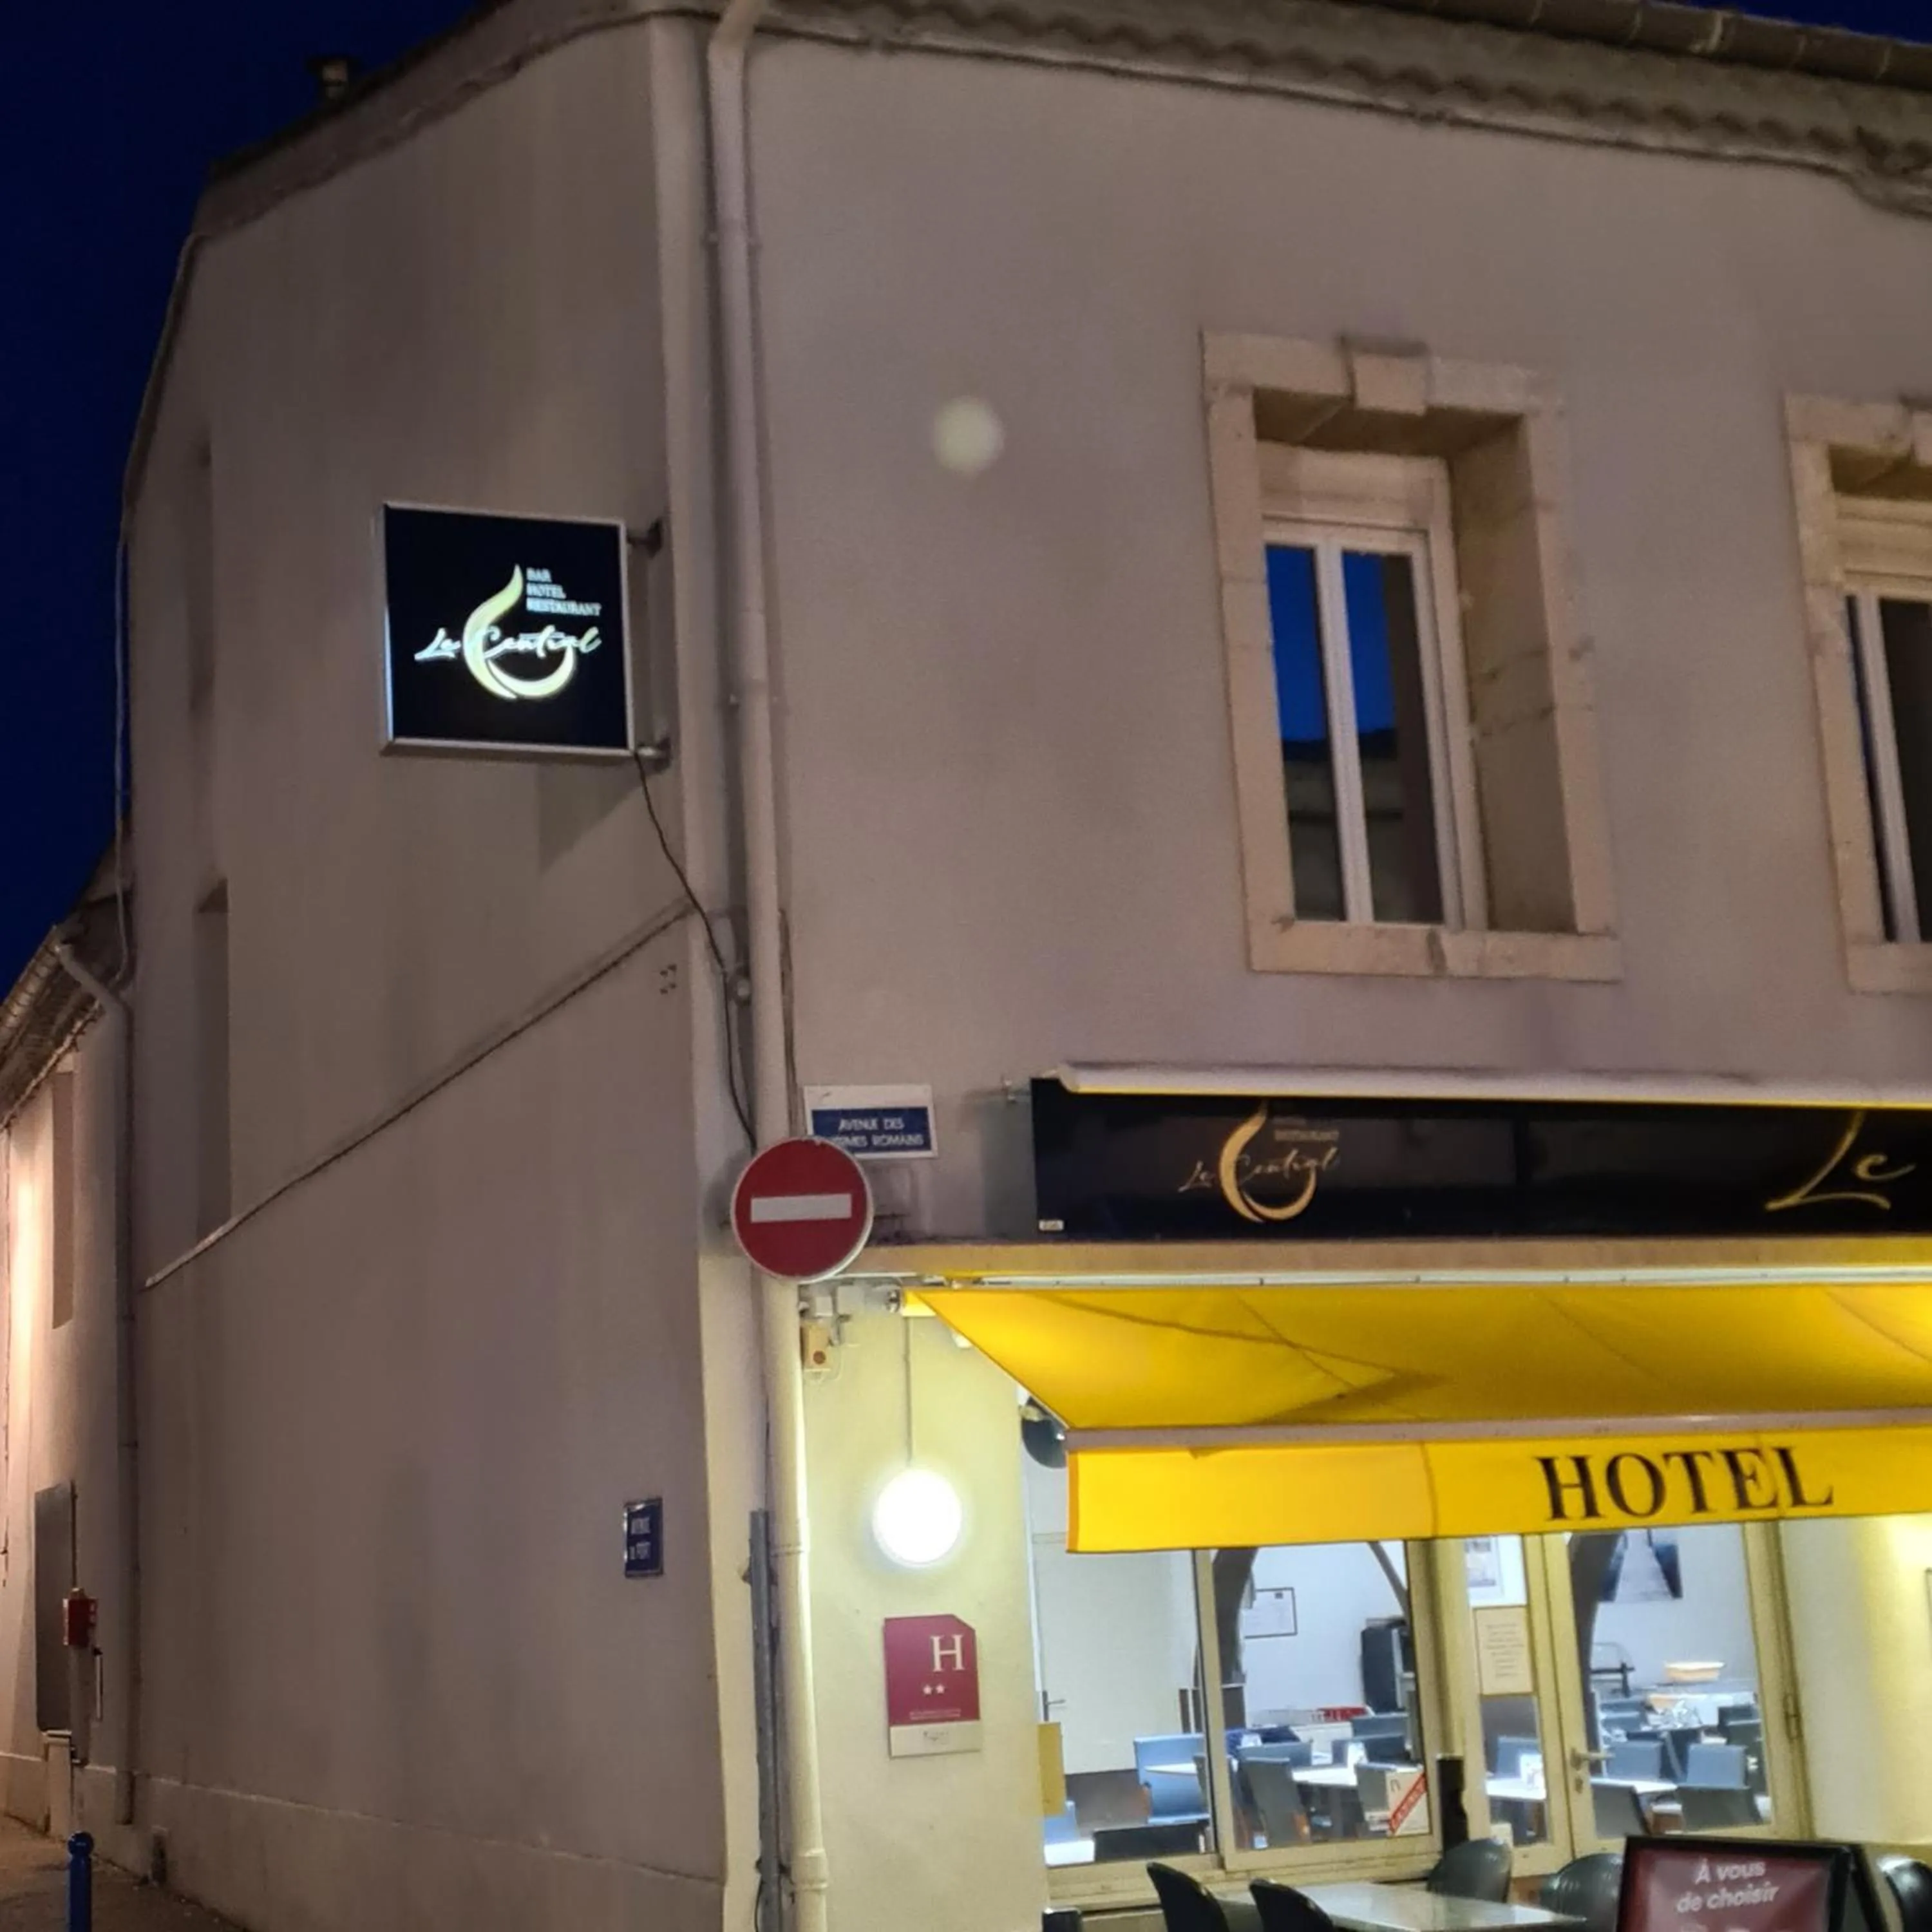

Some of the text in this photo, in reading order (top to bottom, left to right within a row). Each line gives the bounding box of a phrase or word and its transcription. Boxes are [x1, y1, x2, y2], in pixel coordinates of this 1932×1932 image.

[526, 597, 601, 616] RESTAURANT
[414, 627, 461, 661] Le
[838, 1117, 905, 1132] AVENUE DES
[871, 1133, 924, 1146] ROMAINS
[1765, 1109, 1916, 1211] Le
[1535, 1446, 1834, 1520] HOTEL
[931, 1634, 965, 1672] H
[1716, 1861, 1766, 1880] vous
[1676, 1880, 1779, 1913] de choisir
